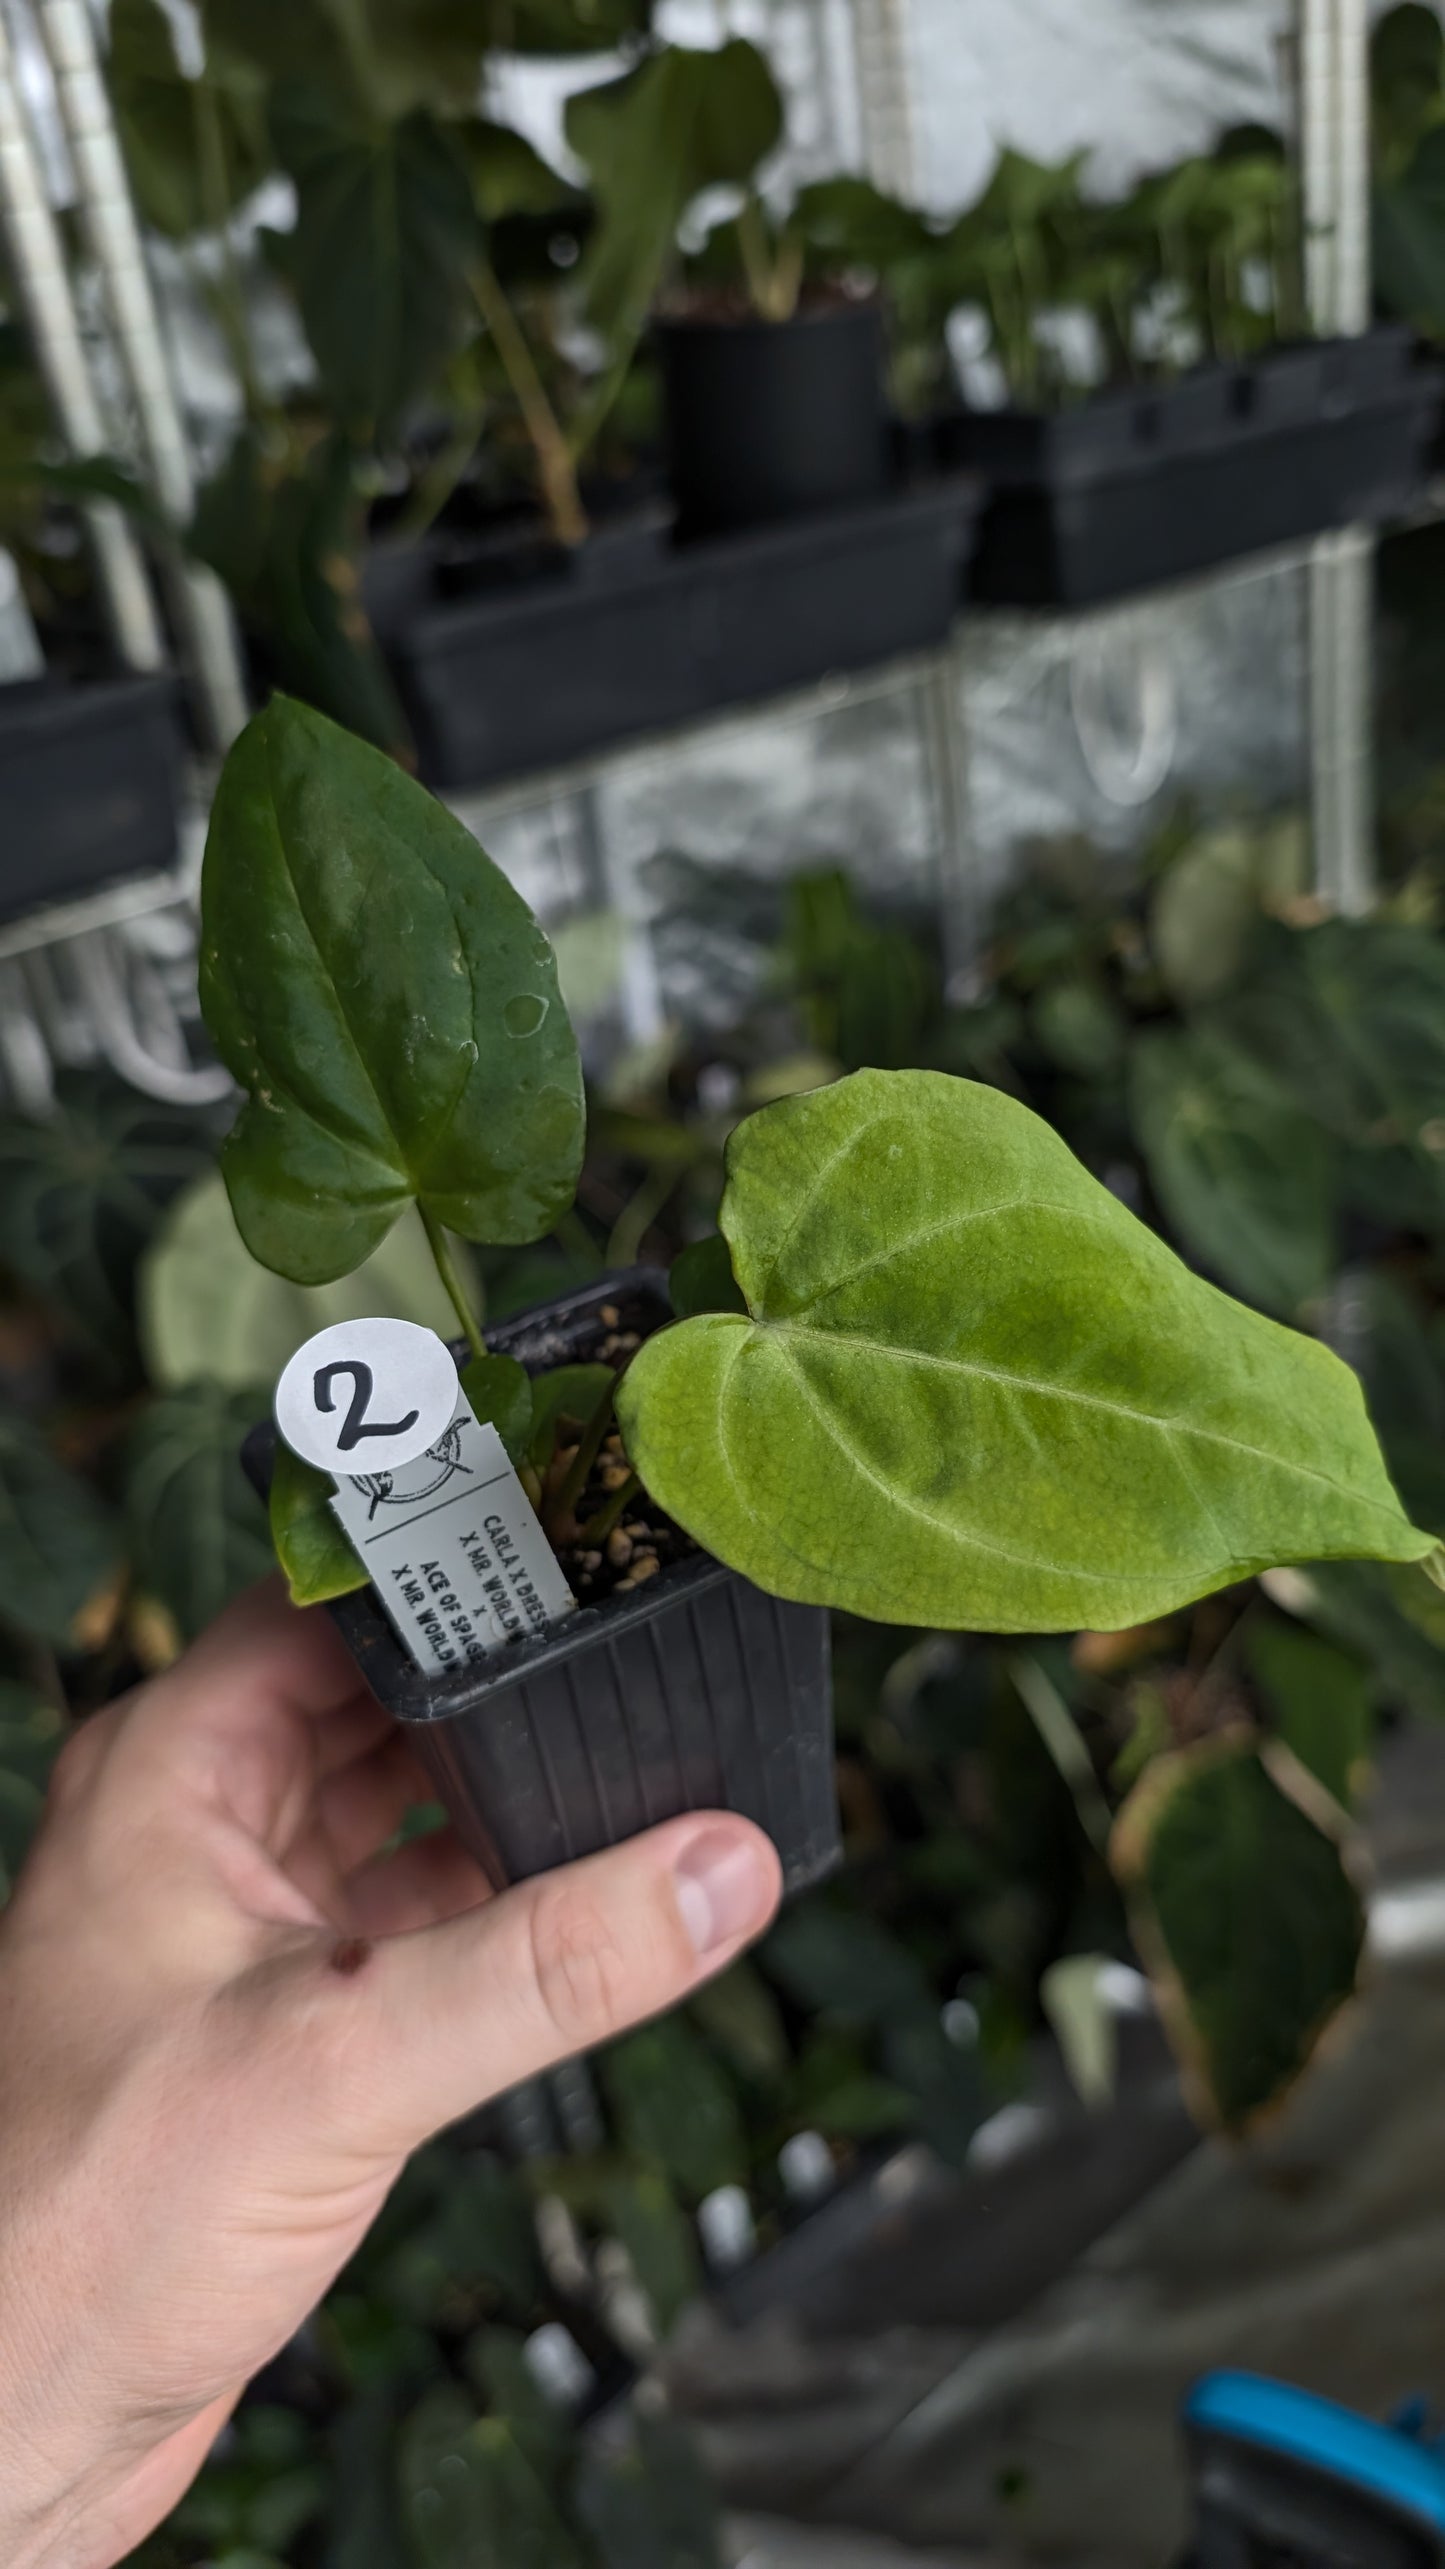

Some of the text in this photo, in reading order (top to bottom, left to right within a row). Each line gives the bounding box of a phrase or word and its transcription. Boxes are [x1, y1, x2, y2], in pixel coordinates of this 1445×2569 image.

[313, 1360, 420, 1451] 2
[459, 1530, 480, 1548] X
[483, 1515, 520, 1569] CARLA
[391, 1563, 412, 1581] X
[467, 1545, 493, 1577] MR.
[400, 1578, 426, 1609] MR.
[420, 1560, 452, 1593] ACE
[439, 1593, 462, 1613] OF
